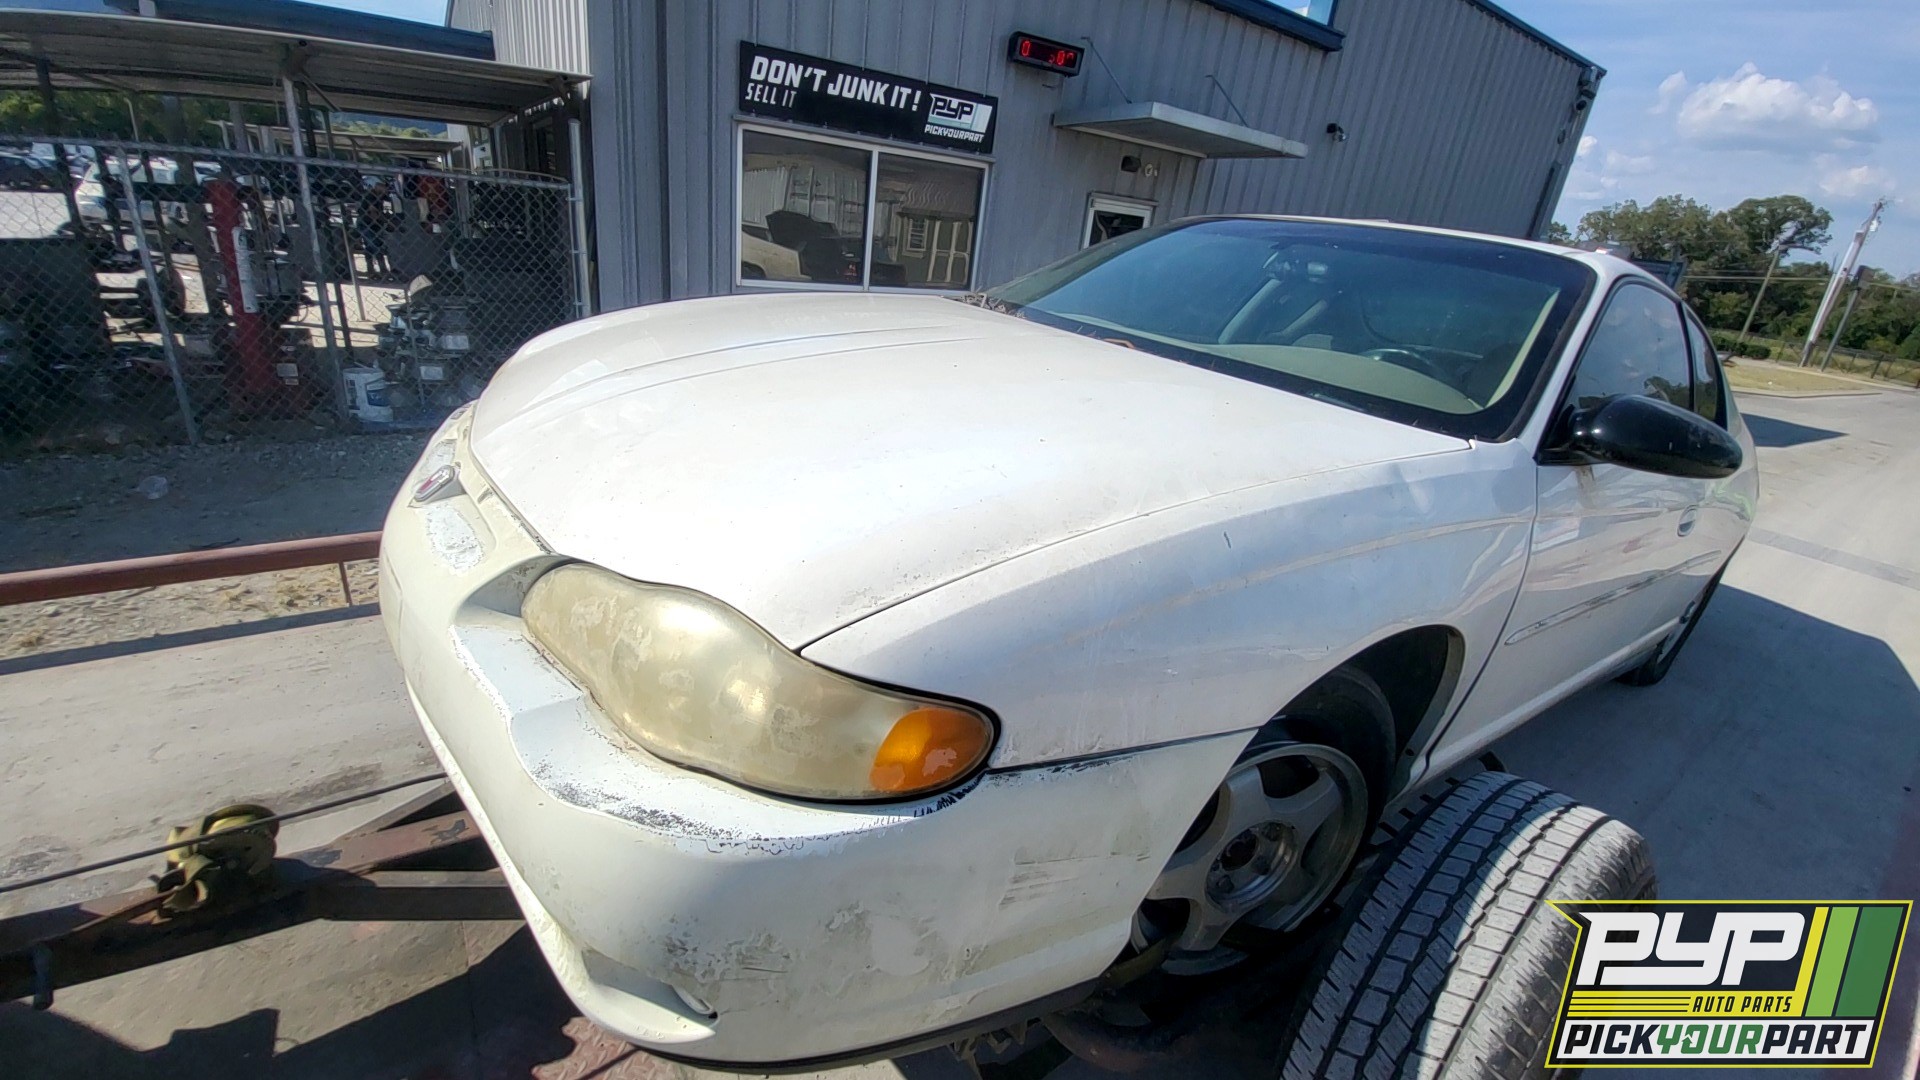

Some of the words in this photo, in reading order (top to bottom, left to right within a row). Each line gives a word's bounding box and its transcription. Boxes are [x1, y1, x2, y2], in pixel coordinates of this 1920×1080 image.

[750, 55, 827, 92] DON'T
[827, 73, 890, 105] JUNK
[745, 82, 777, 105] SELL
[782, 89, 797, 108] IT
[931, 96, 974, 121] PYP
[924, 124, 985, 143] PICKYOURPART
